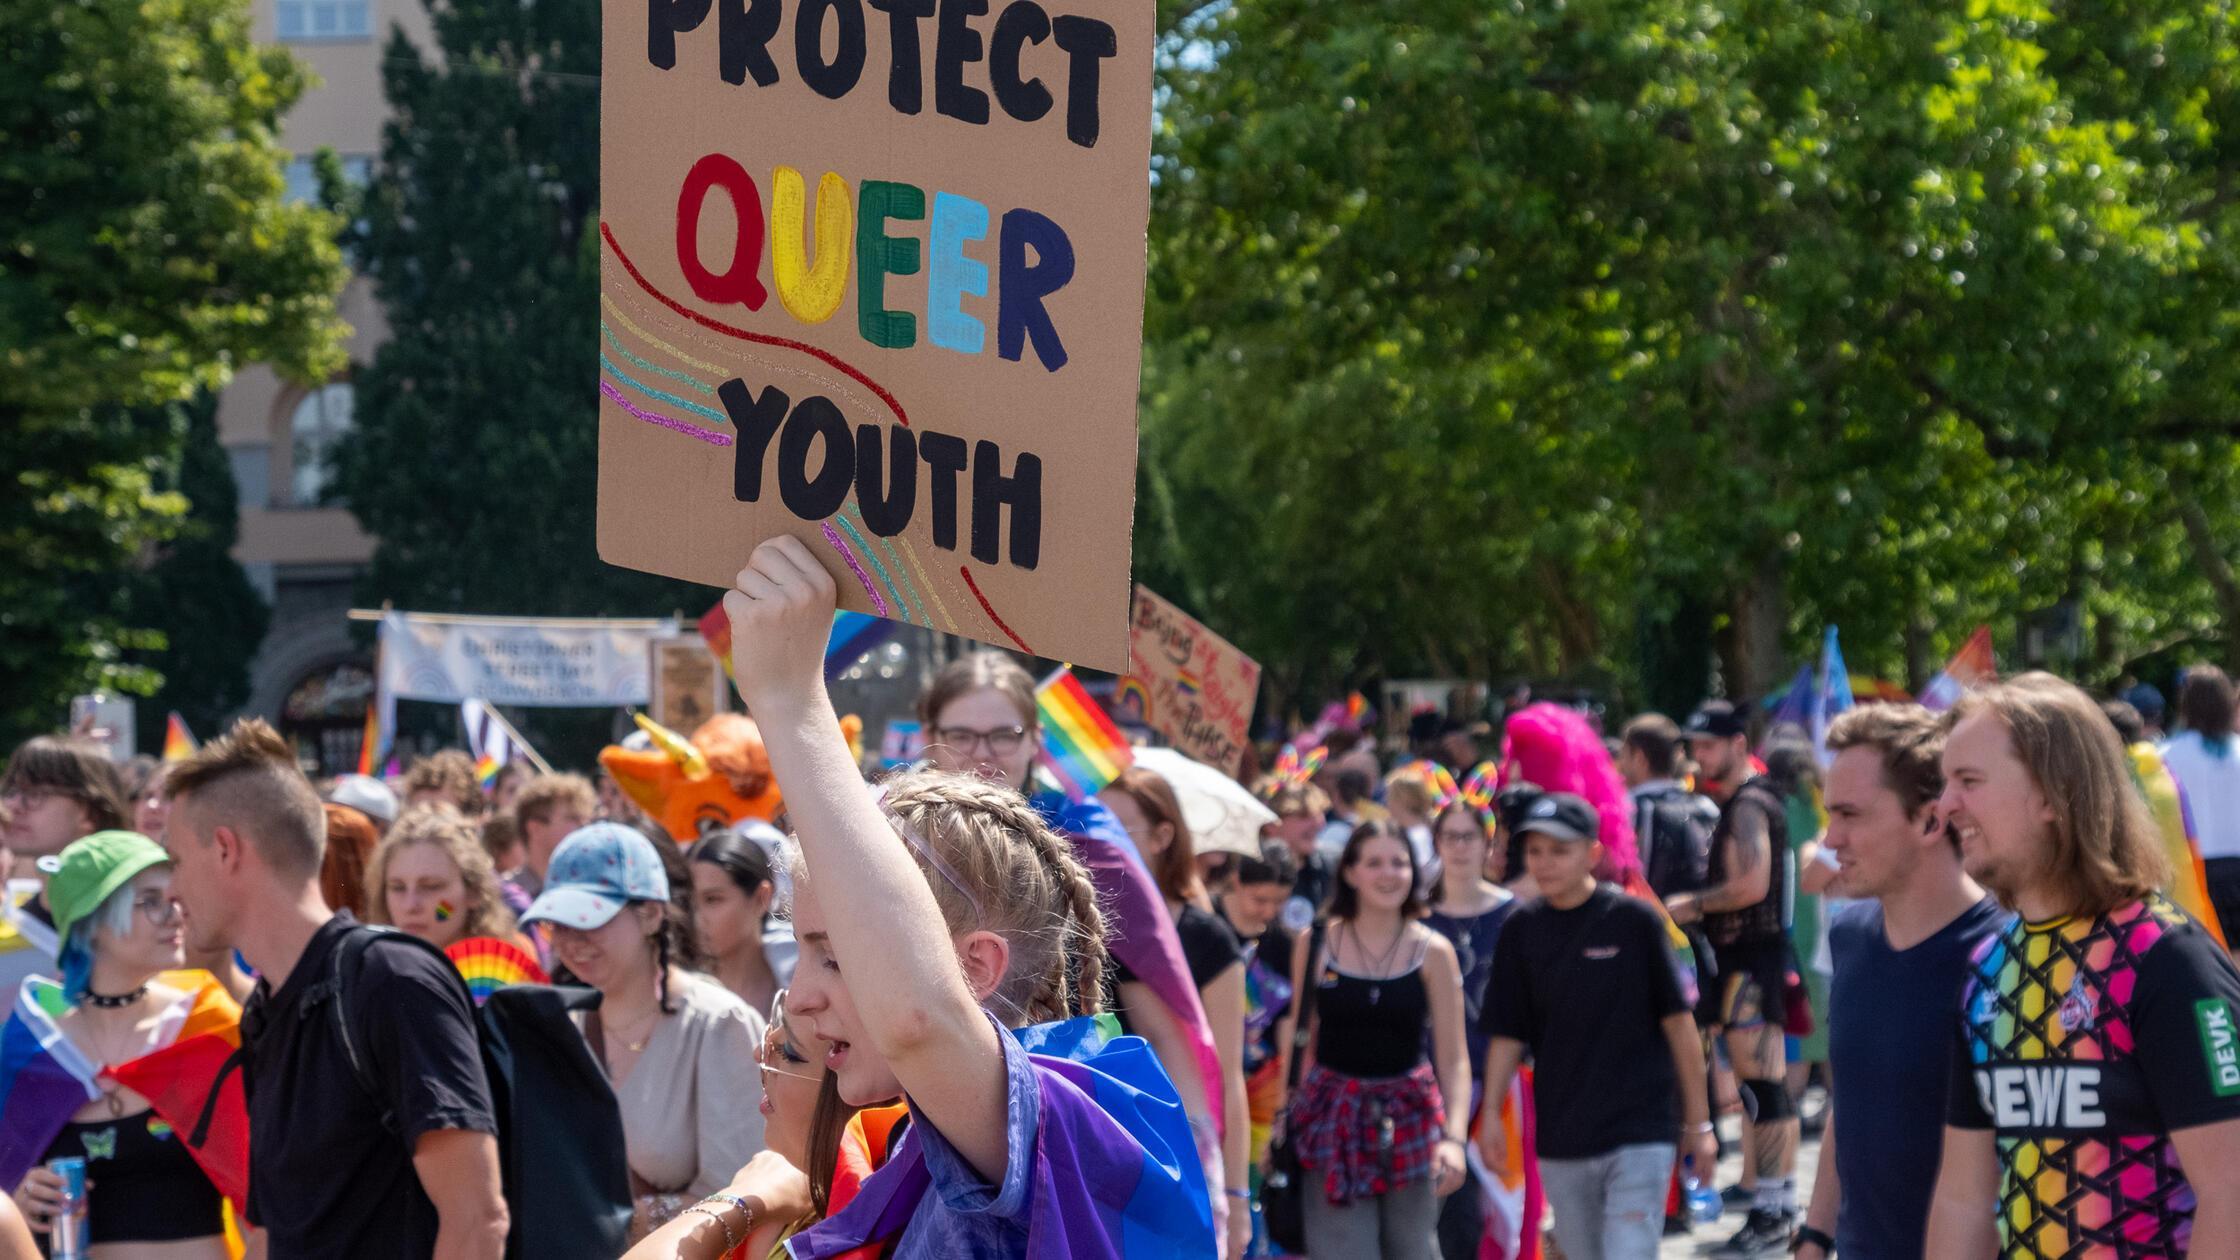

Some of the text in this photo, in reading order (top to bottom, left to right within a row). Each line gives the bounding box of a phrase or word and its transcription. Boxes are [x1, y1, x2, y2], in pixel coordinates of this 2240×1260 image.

[647, 0, 1117, 148] PROTECT
[676, 153, 1075, 373] QUEER
[718, 378, 1042, 571] YOUTH
[2206, 1007, 2240, 1087] DEVK
